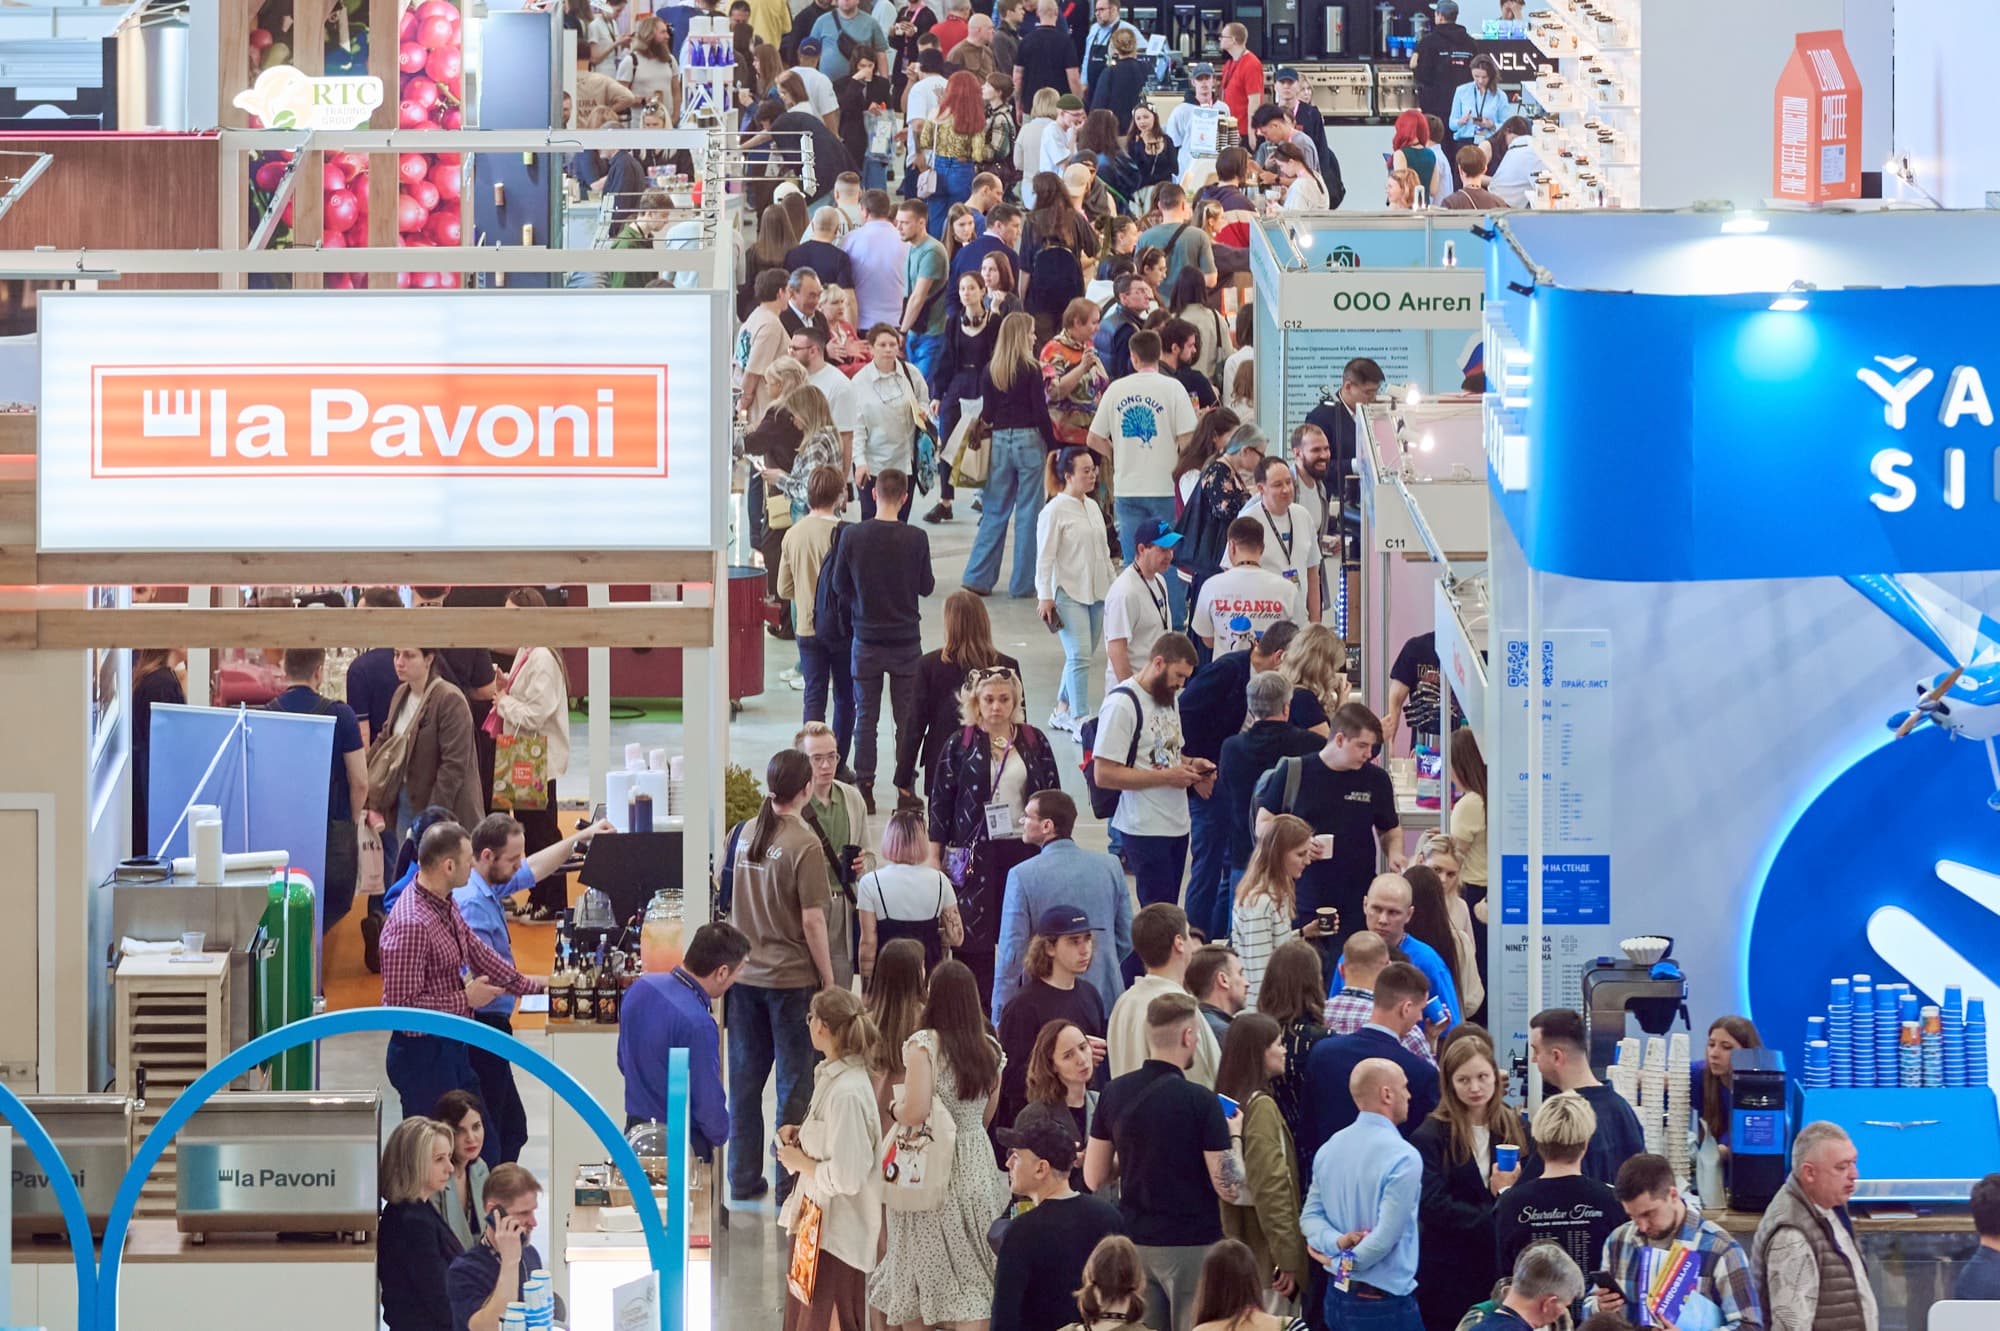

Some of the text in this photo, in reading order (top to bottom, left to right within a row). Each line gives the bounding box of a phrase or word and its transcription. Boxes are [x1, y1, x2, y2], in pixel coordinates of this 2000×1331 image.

[312, 83, 377, 105] RTC
[321, 116, 353, 125] GROUP
[1820, 94, 1848, 141] COFFEE
[1780, 145, 1808, 177] COFFEE
[1333, 291, 1391, 311] ООО
[1398, 291, 1471, 311] Ангел
[1117, 394, 1164, 414] KONG QUE
[210, 388, 615, 458] la Pavoni
[1215, 599, 1284, 613] EL CANTO
[1561, 679, 1609, 688] ПРАЙС-ЛИСТ
[1550, 864, 1561, 872] НА
[1562, 863, 1591, 872] СТЕНДЕ
[235, 1169, 336, 1187] la Pavoni
[1517, 1204, 1604, 1223] Skuratov Team
